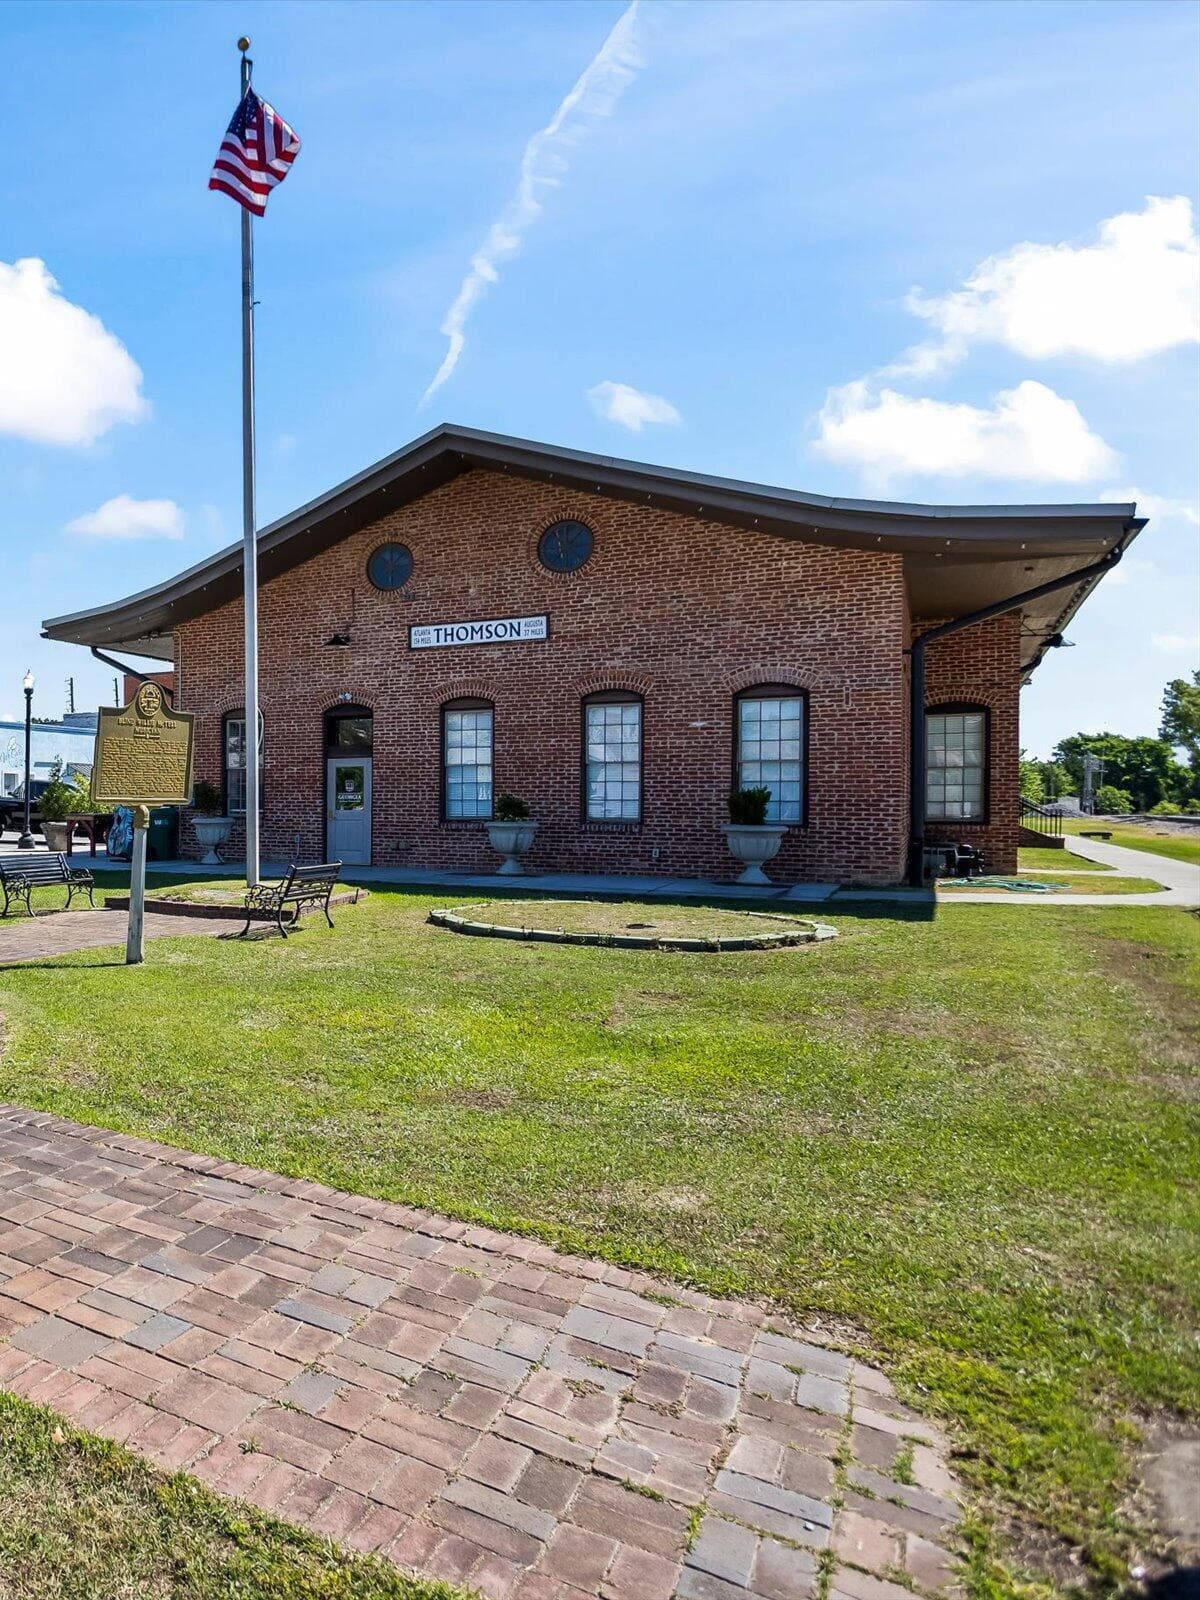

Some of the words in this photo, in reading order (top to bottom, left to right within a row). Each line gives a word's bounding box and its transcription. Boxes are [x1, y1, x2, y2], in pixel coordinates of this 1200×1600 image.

[524, 619, 543, 628] AUGUSTA
[413, 629, 431, 637] ATLANTA
[433, 621, 521, 644] THOMSON
[530, 628, 544, 636] MILES
